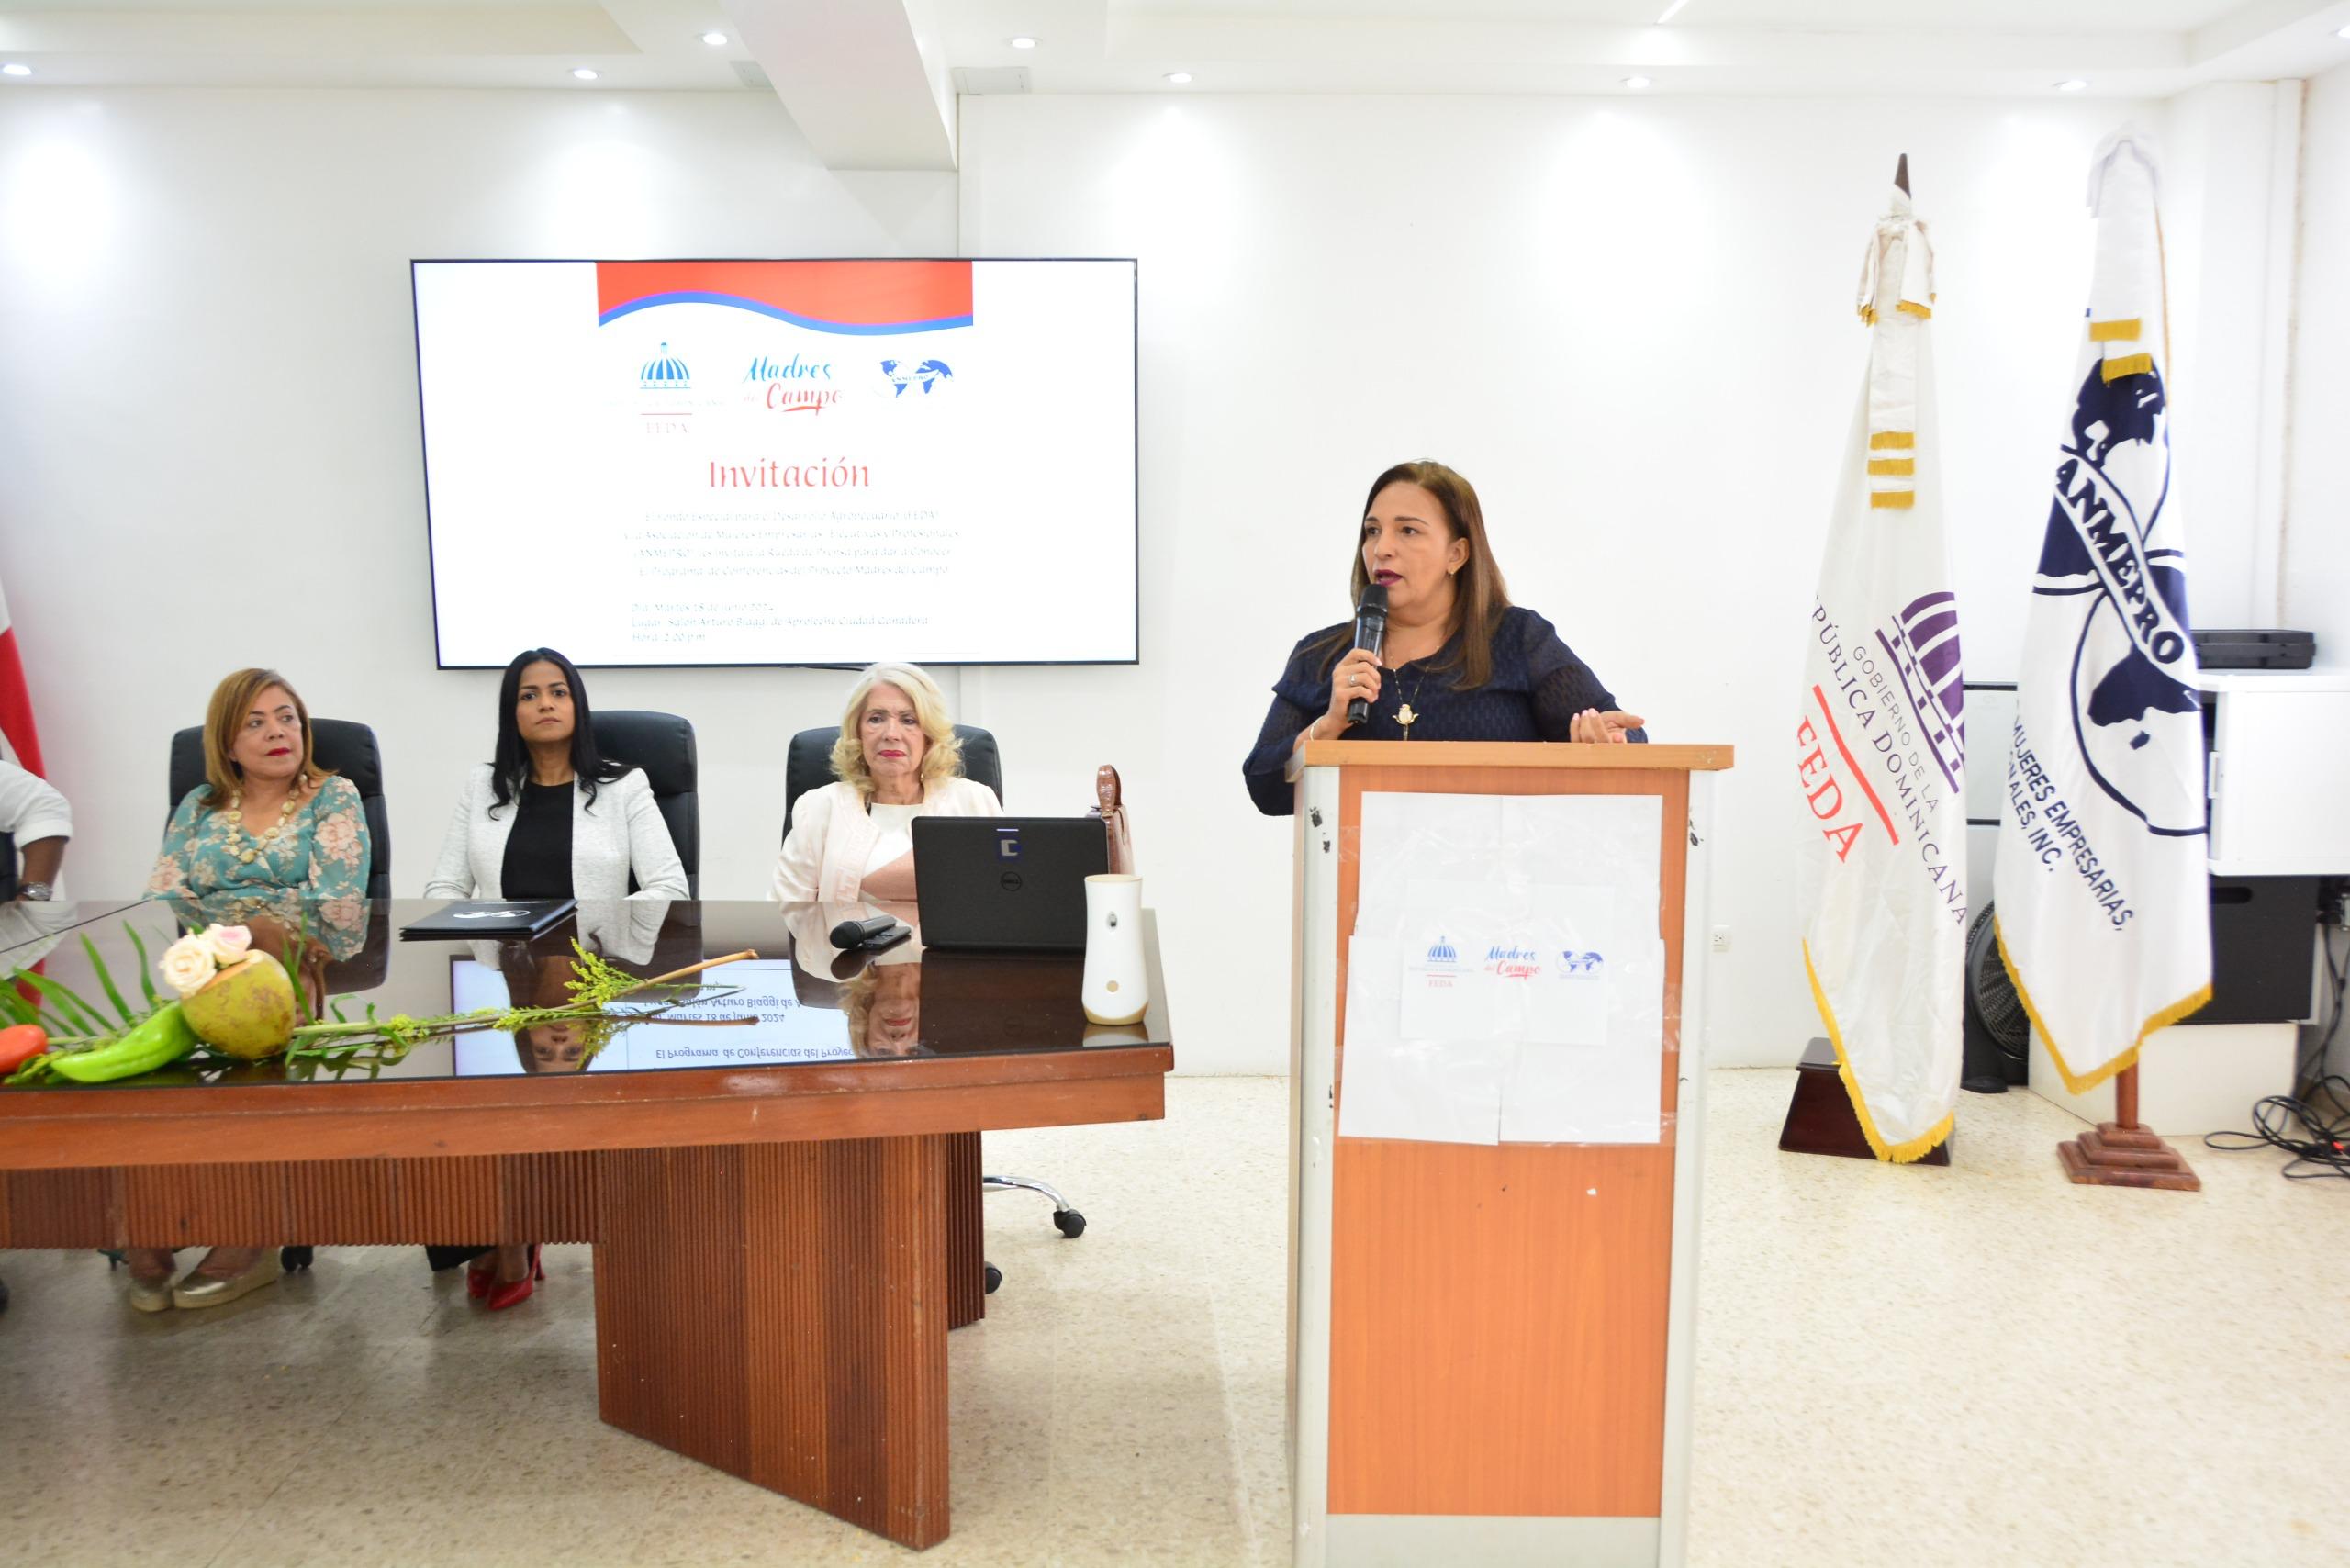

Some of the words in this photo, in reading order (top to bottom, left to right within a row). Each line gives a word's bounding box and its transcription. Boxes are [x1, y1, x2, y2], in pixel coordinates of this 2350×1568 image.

[742, 353, 832, 383] Madres
[767, 382, 843, 416] Campo
[708, 456, 871, 488] Invitación
[2054, 458, 2187, 666] ANMEPRO
[1852, 645, 1911, 746] GOBIERNO
[1908, 751, 1925, 779] DE
[1919, 784, 1940, 814] LA
[1812, 594, 1876, 729] PÚBLICA
[1872, 730, 1968, 925] DOMINICANA
[2028, 827, 2063, 872] INC.
[2043, 800, 2137, 932] EMPRESARIAS,
[1484, 945, 1536, 962] Madres
[1496, 960, 1540, 980] Campo
